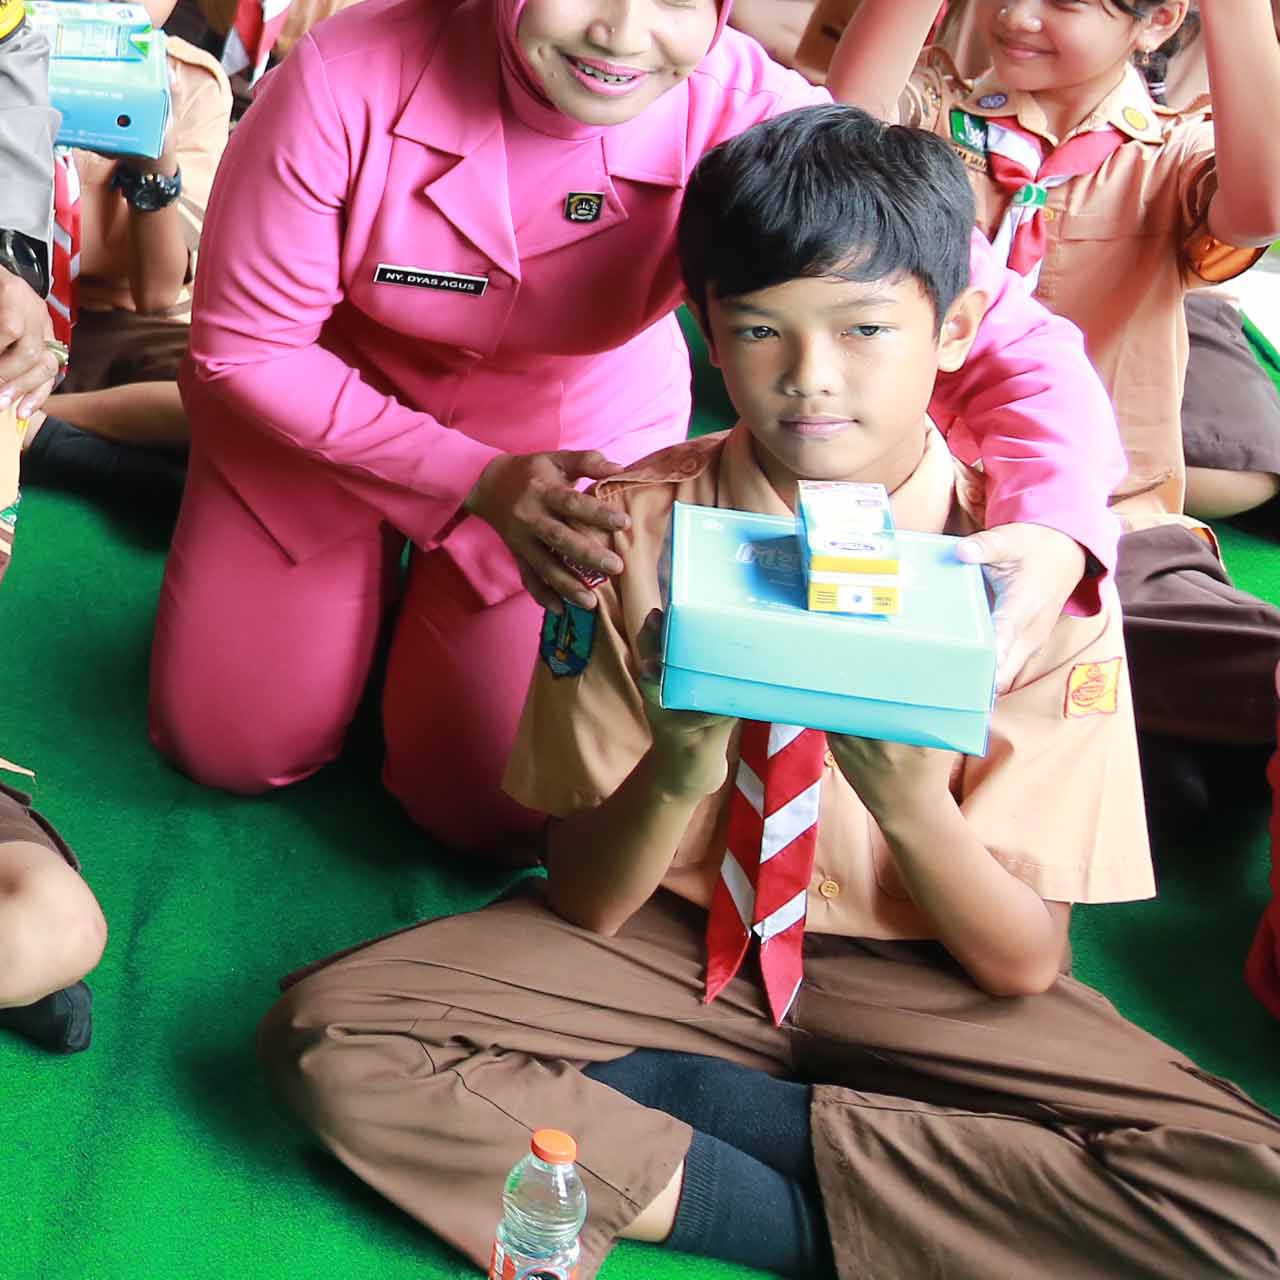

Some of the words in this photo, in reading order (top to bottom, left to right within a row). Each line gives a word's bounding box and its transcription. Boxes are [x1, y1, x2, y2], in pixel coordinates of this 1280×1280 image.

[386, 272, 404, 281] NY.
[407, 274, 438, 286] DYAS
[440, 280, 475, 291] AGUS
